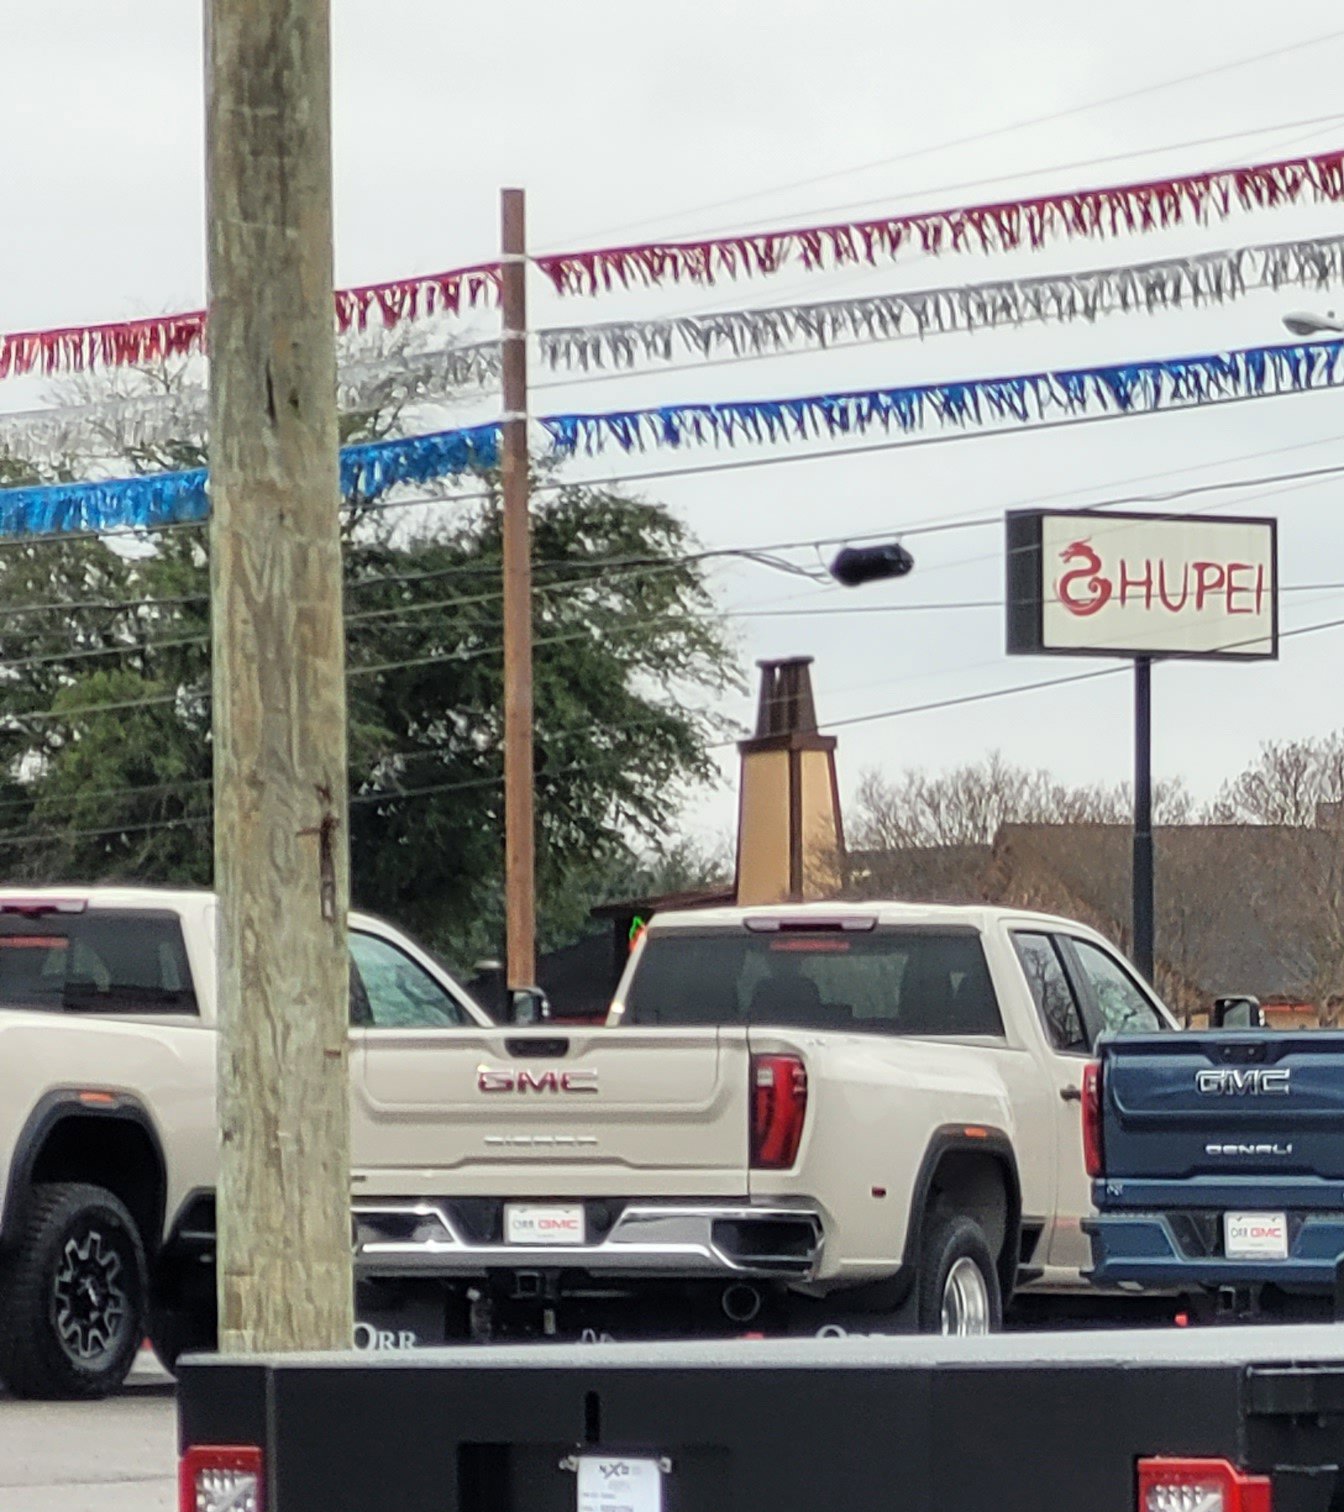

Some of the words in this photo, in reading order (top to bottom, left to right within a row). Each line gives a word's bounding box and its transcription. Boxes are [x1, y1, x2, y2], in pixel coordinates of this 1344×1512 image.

[1120, 558, 1264, 616] HUPEI
[477, 1066, 598, 1094] GMC
[1195, 1068, 1290, 1096] GMC
[1205, 1143, 1292, 1155] DENALI
